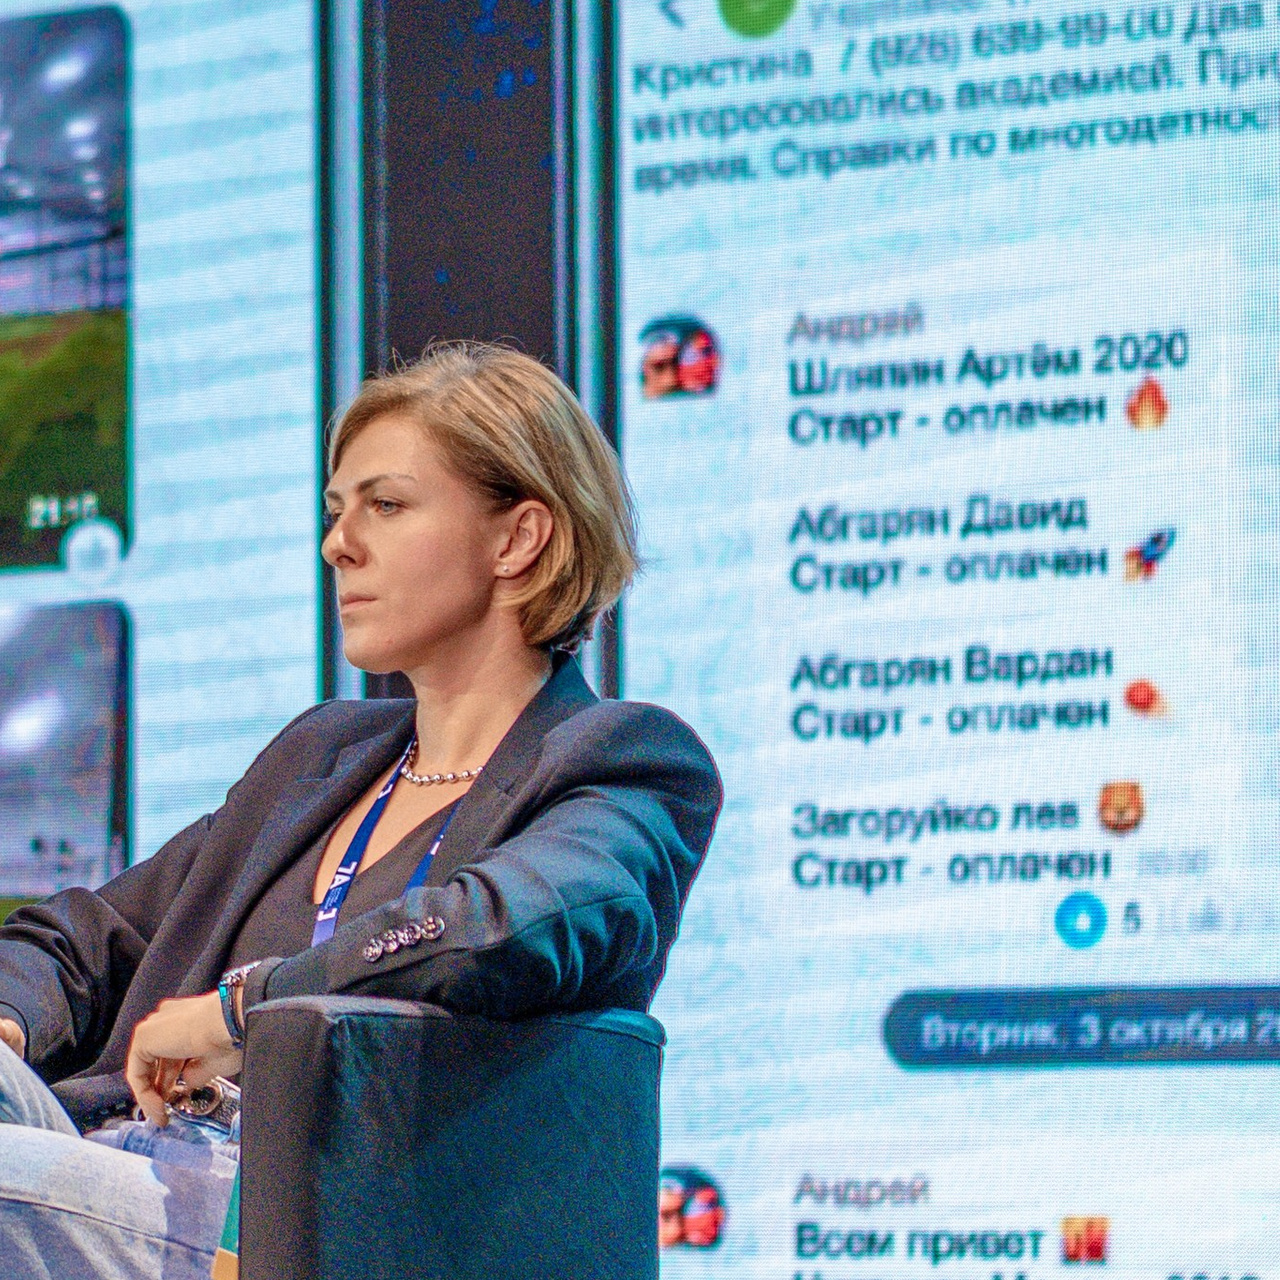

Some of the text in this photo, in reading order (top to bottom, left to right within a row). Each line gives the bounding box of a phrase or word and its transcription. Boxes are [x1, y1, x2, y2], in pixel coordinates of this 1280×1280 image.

[632, 48, 814, 102] Кристина
[772, 132, 937, 182] Справки
[949, 128, 998, 162] по
[1092, 328, 1190, 374] 2020
[788, 406, 903, 450] Старт
[789, 493, 1089, 546] Абгарян Давид
[790, 554, 906, 598] Старт
[790, 642, 1114, 694] Абгарян Вардан
[791, 702, 907, 745] Старт
[791, 798, 1001, 844] Загоруйко
[792, 850, 908, 895] Старт
[1078, 1011, 1100, 1048] 3
